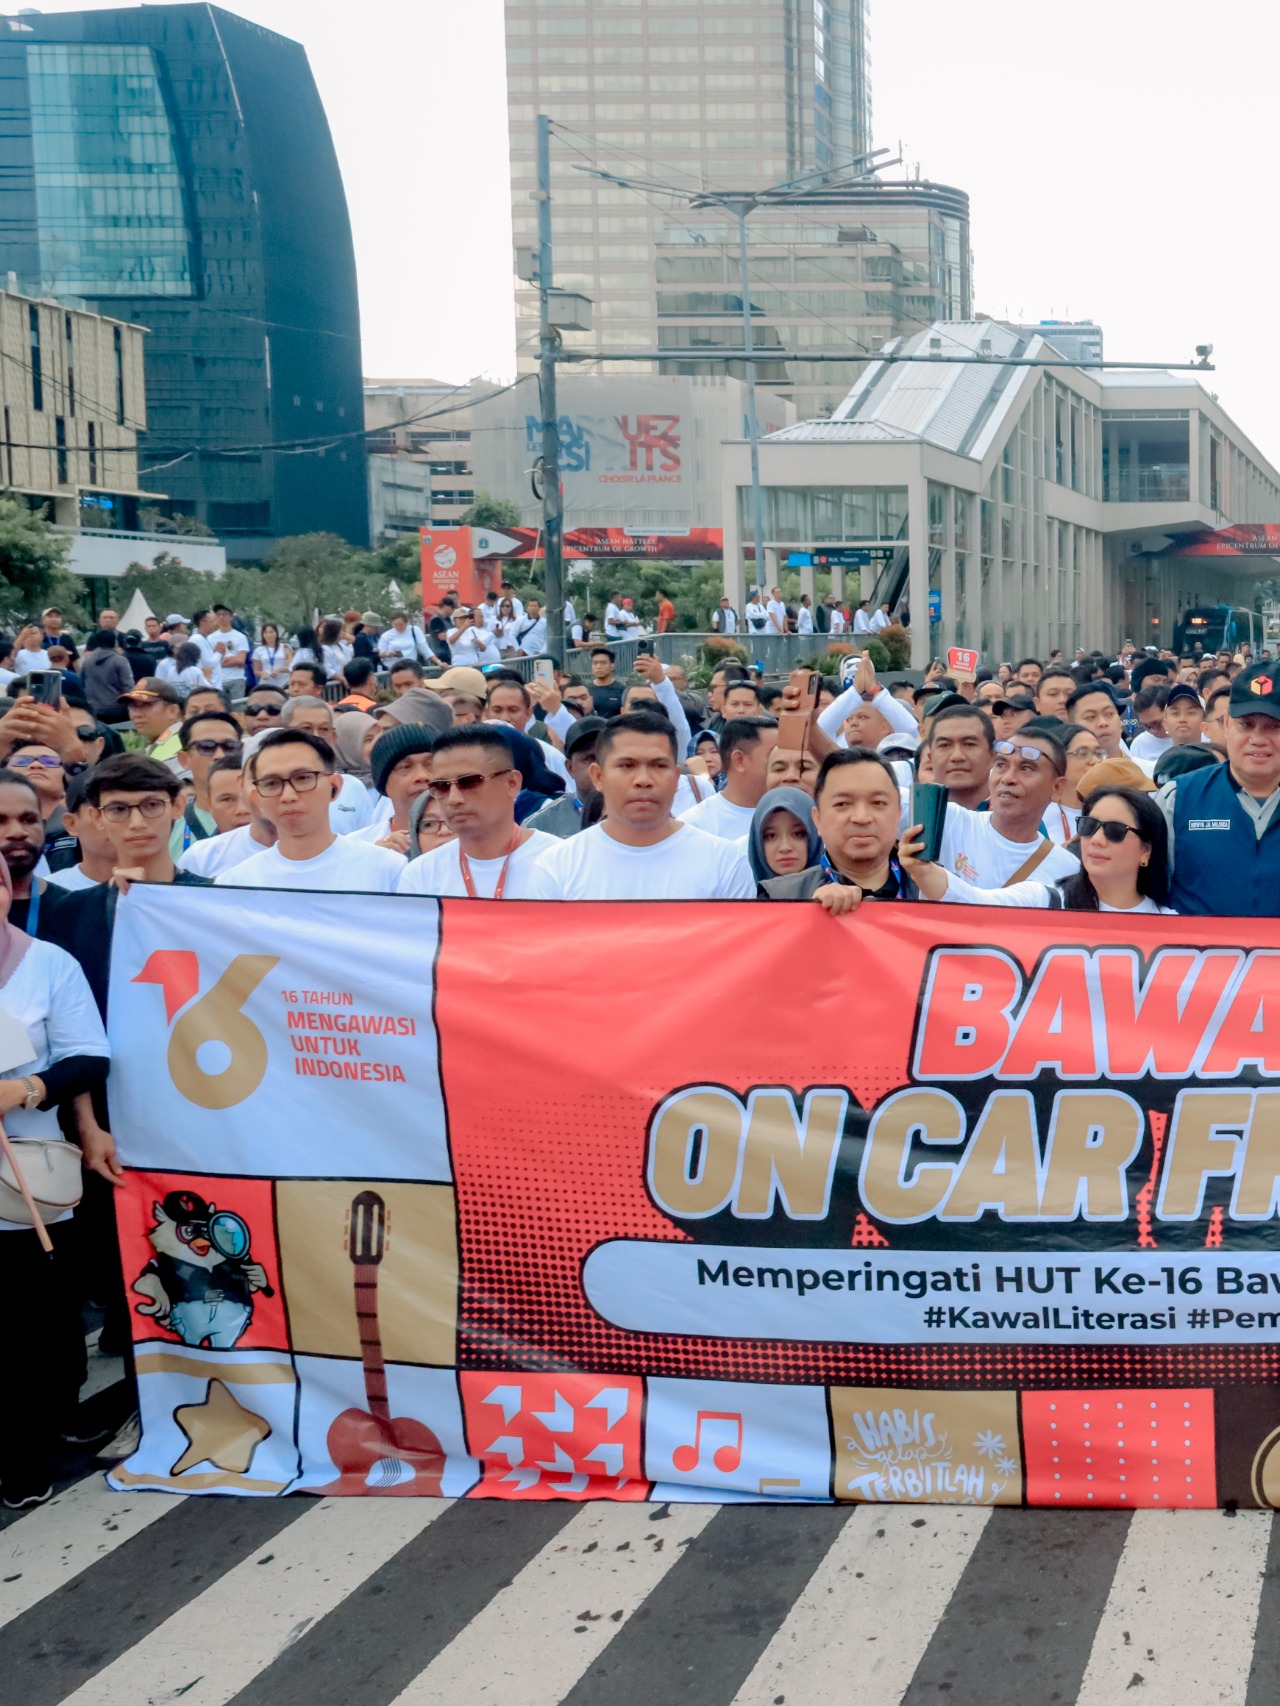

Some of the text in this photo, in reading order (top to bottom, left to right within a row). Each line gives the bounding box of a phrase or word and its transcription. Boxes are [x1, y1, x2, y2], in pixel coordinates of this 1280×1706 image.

[648, 475, 682, 483] FRANCE
[432, 570, 459, 578] ASEAN
[956, 651, 970, 663] 16
[281, 990, 353, 1006] 16 TAHUN
[287, 1011, 416, 1036] MENGAWASI
[290, 1035, 361, 1056] UNTUK
[295, 1057, 406, 1083] INDONESIA
[647, 1087, 849, 1220] ON
[858, 1087, 1145, 1224] CAR
[696, 1258, 982, 1299] Memperingati
[995, 1265, 1080, 1294] HUT
[1093, 1265, 1203, 1295] Ke-16
[923, 1305, 1177, 1331] #KawalLiterasi
[852, 1408, 936, 1451] HABIS
[847, 1461, 985, 1501] TERBITLAH
